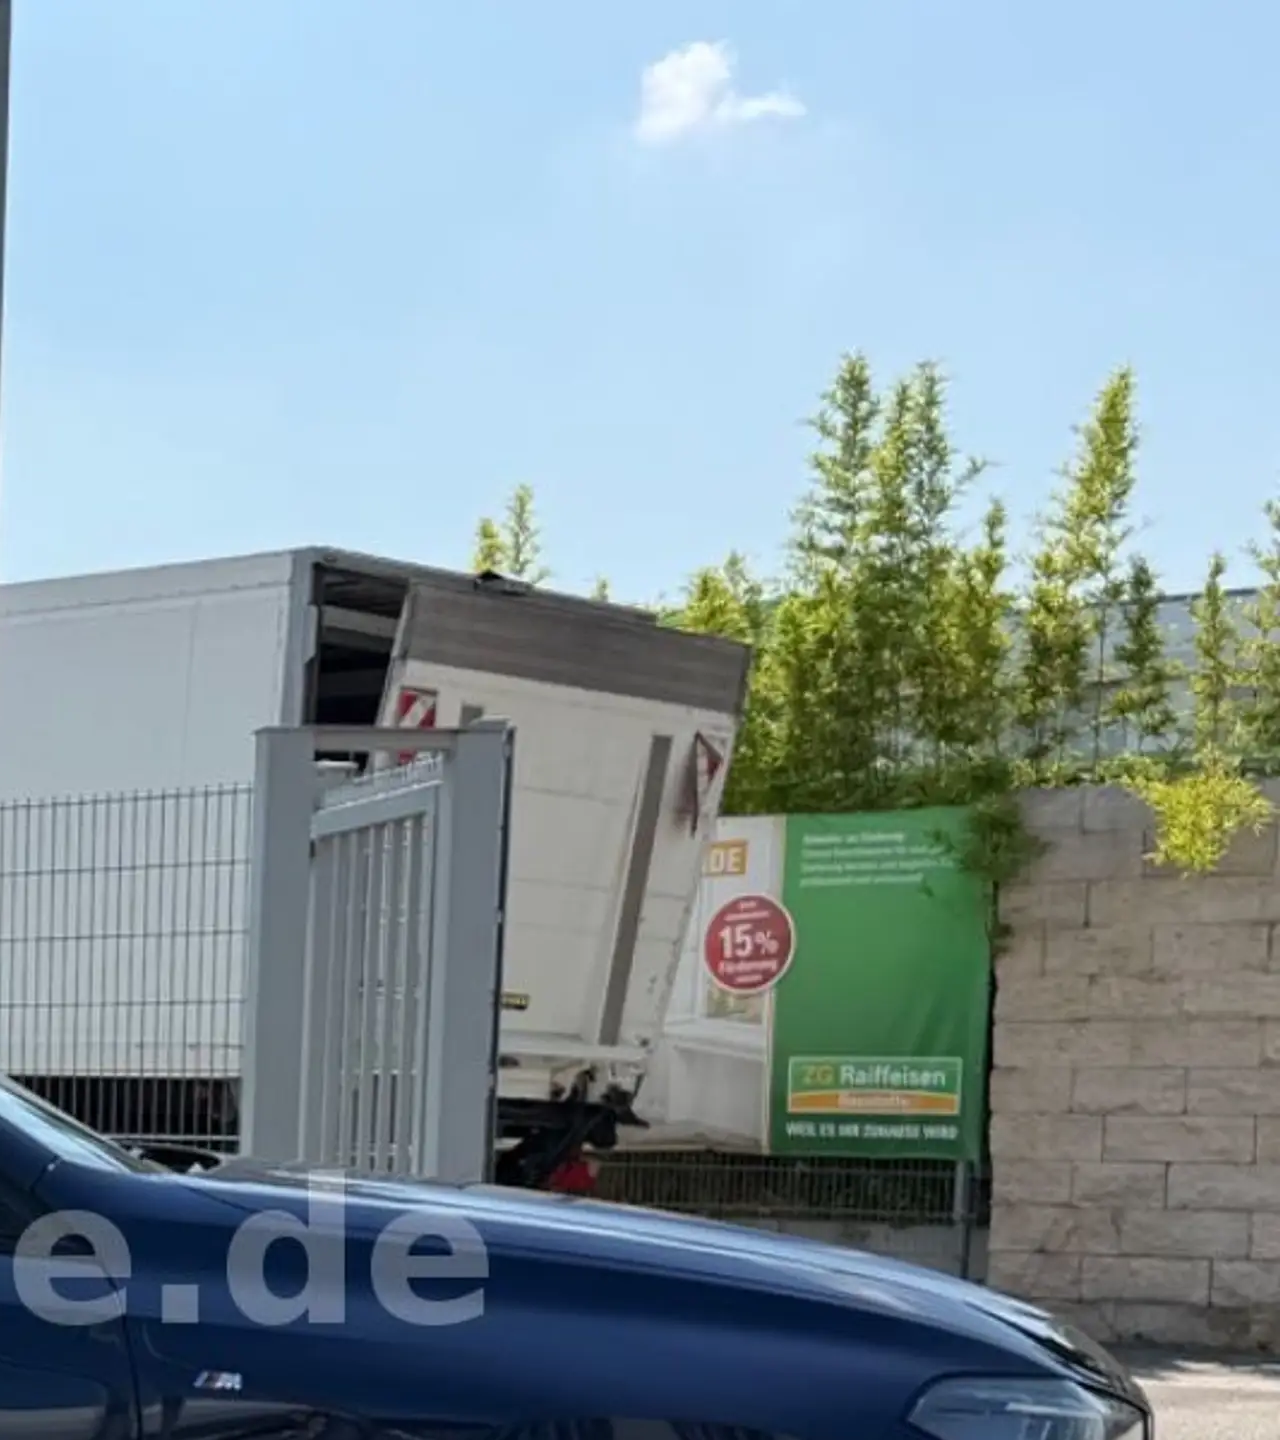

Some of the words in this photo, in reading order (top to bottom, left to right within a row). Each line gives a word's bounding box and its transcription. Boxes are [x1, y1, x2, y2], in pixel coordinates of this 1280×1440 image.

[718, 923, 779, 959] 15%
[801, 1064, 835, 1085] ZG
[839, 1064, 947, 1087] Raiffeisen
